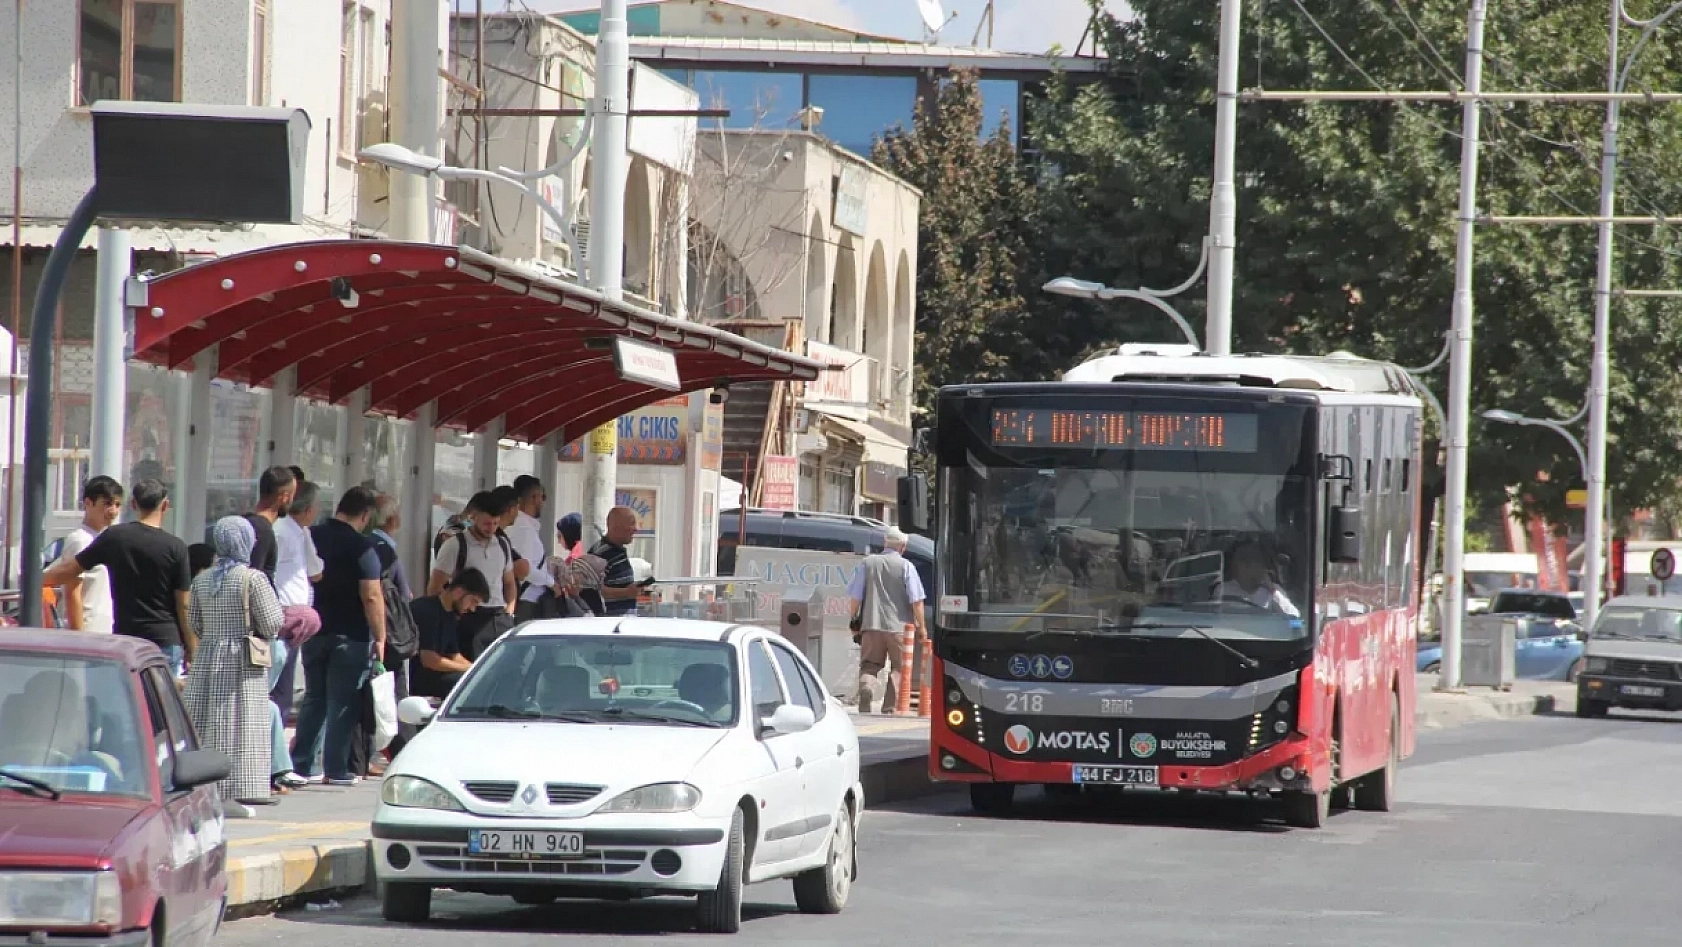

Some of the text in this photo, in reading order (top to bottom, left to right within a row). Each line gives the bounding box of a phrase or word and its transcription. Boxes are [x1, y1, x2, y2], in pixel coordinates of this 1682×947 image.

[1004, 692, 1044, 713] 218
[1036, 730, 1111, 753] MOTAŞ
[1082, 767, 1153, 782] 44 FJ 218
[480, 833, 580, 852] 02 HN 940
